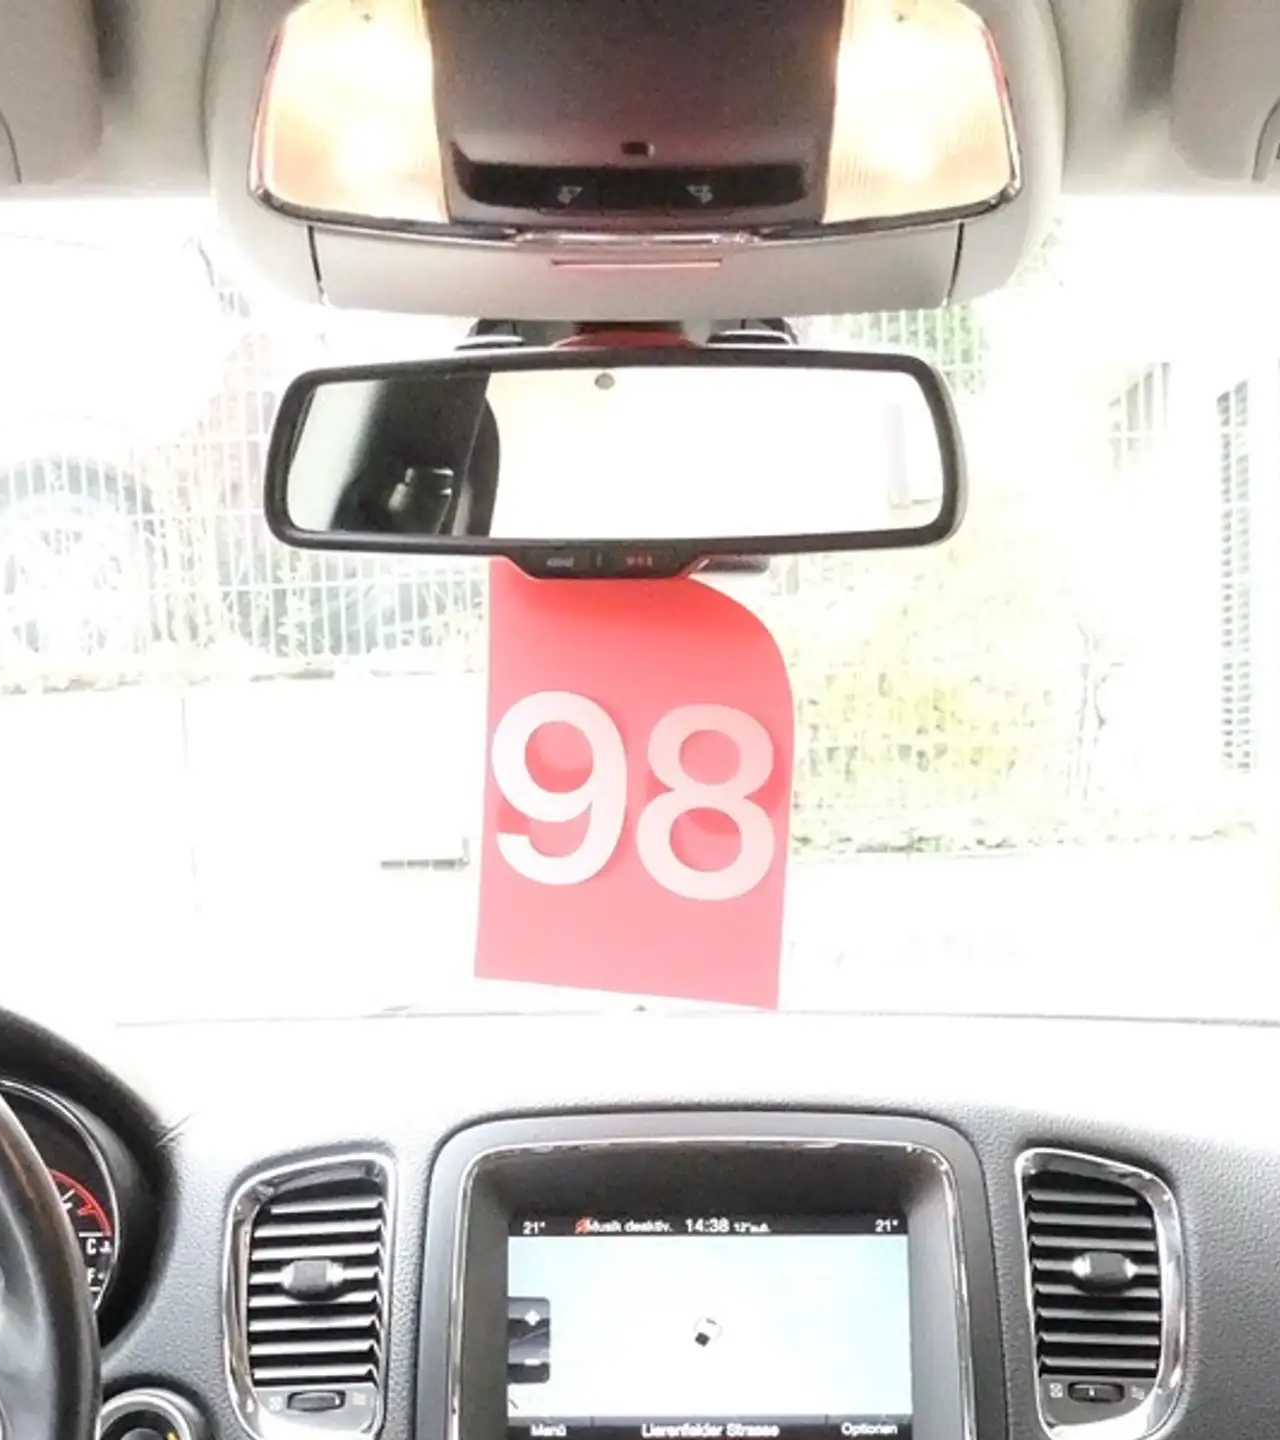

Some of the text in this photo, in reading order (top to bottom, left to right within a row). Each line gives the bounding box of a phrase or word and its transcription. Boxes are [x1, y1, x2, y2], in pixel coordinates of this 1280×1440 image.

[492, 690, 776, 901] 98
[522, 1220, 546, 1235] 21°
[684, 1217, 730, 1234] 14:38
[874, 1218, 899, 1233] 21°
[86, 1238, 97, 1255] C
[530, 1422, 567, 1437] Menü
[726, 1422, 781, 1438] Strasse
[840, 1421, 899, 1437] Optionen
